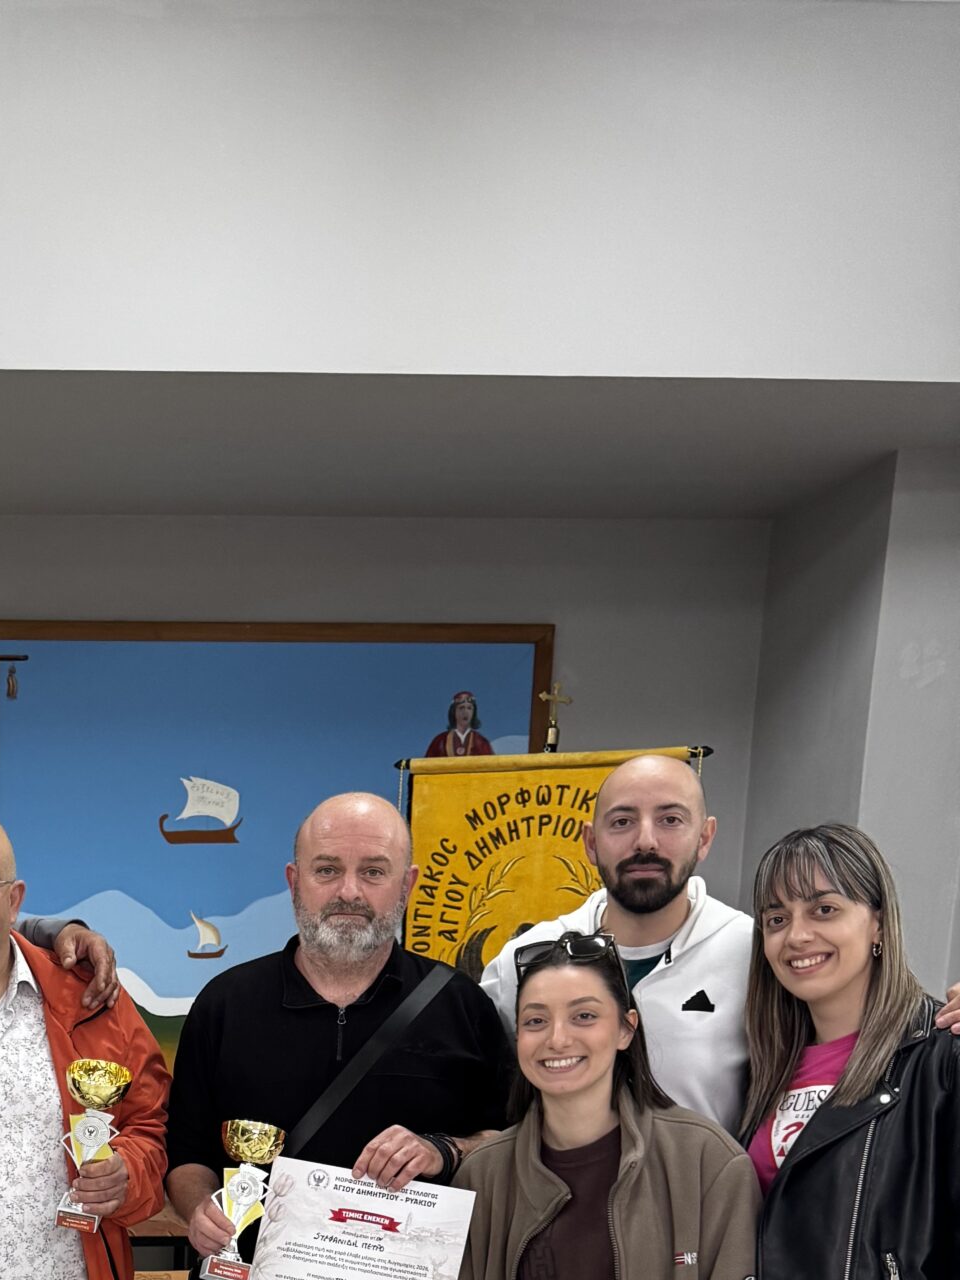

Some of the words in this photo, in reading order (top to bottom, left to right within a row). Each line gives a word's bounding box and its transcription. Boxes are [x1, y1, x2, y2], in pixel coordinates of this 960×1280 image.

[465, 785, 598, 831] ΜΟΡΦΩΤΙΚ
[438, 873, 469, 943] ΑΓΙΟΥ
[779, 1090, 827, 1112] GUES
[333, 1184, 355, 1193] ΑΓΙΟΥ
[356, 1188, 399, 1201] ΔΗΜΗΤΡΙΟΥ
[405, 1197, 437, 1208] ΡΥΑΚΙΟΥ
